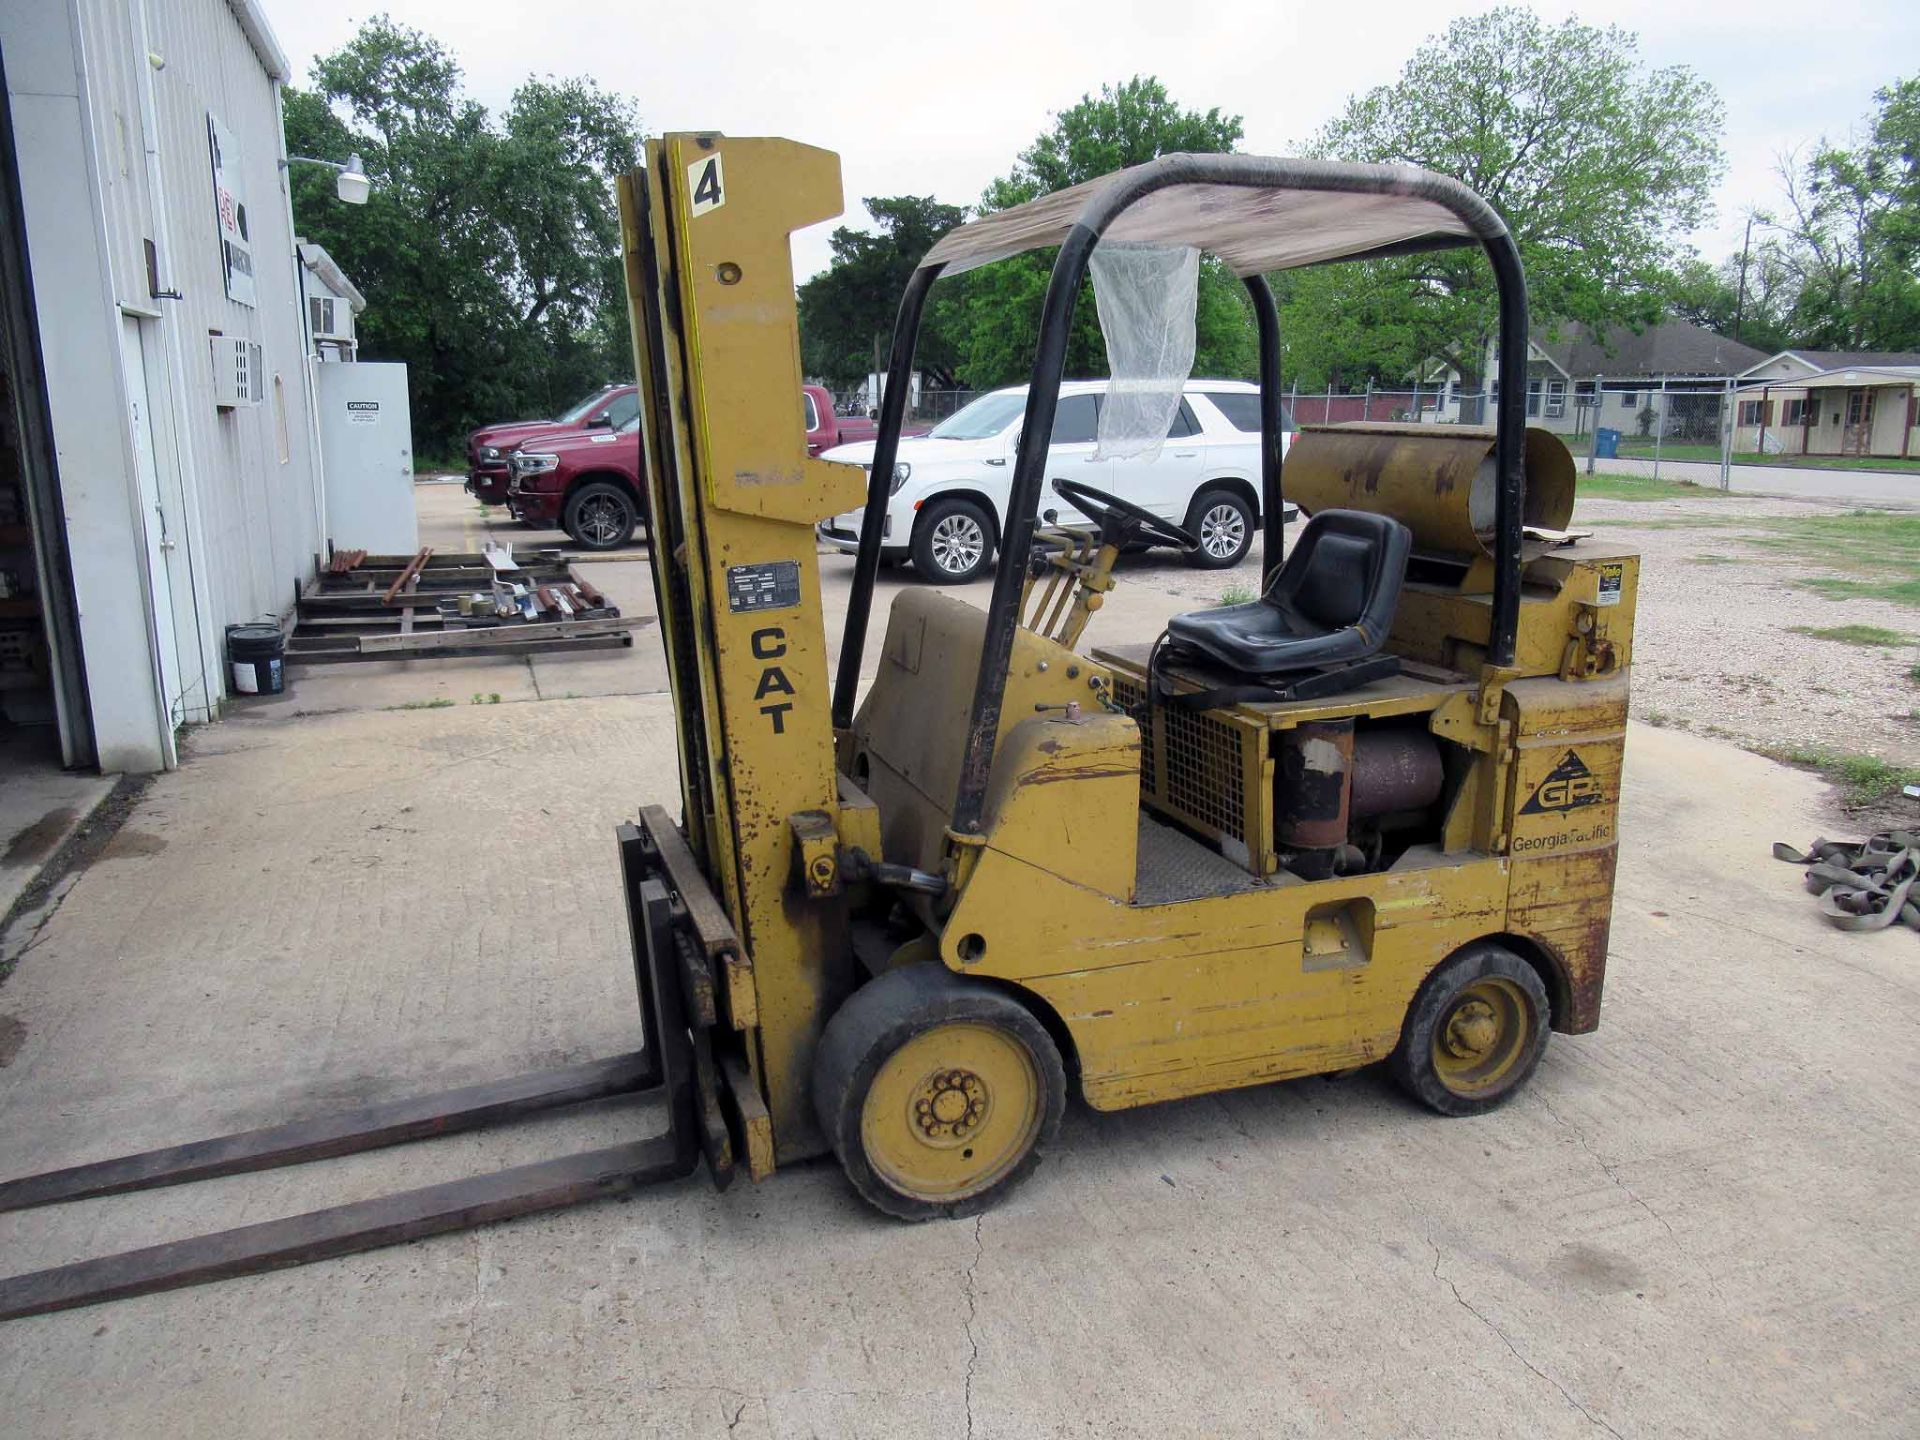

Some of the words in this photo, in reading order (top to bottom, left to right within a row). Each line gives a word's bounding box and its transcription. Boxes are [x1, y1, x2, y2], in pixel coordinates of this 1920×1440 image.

[694, 159, 721, 204] 4
[751, 628, 795, 734] CAT
[1538, 776, 1600, 808] GP
